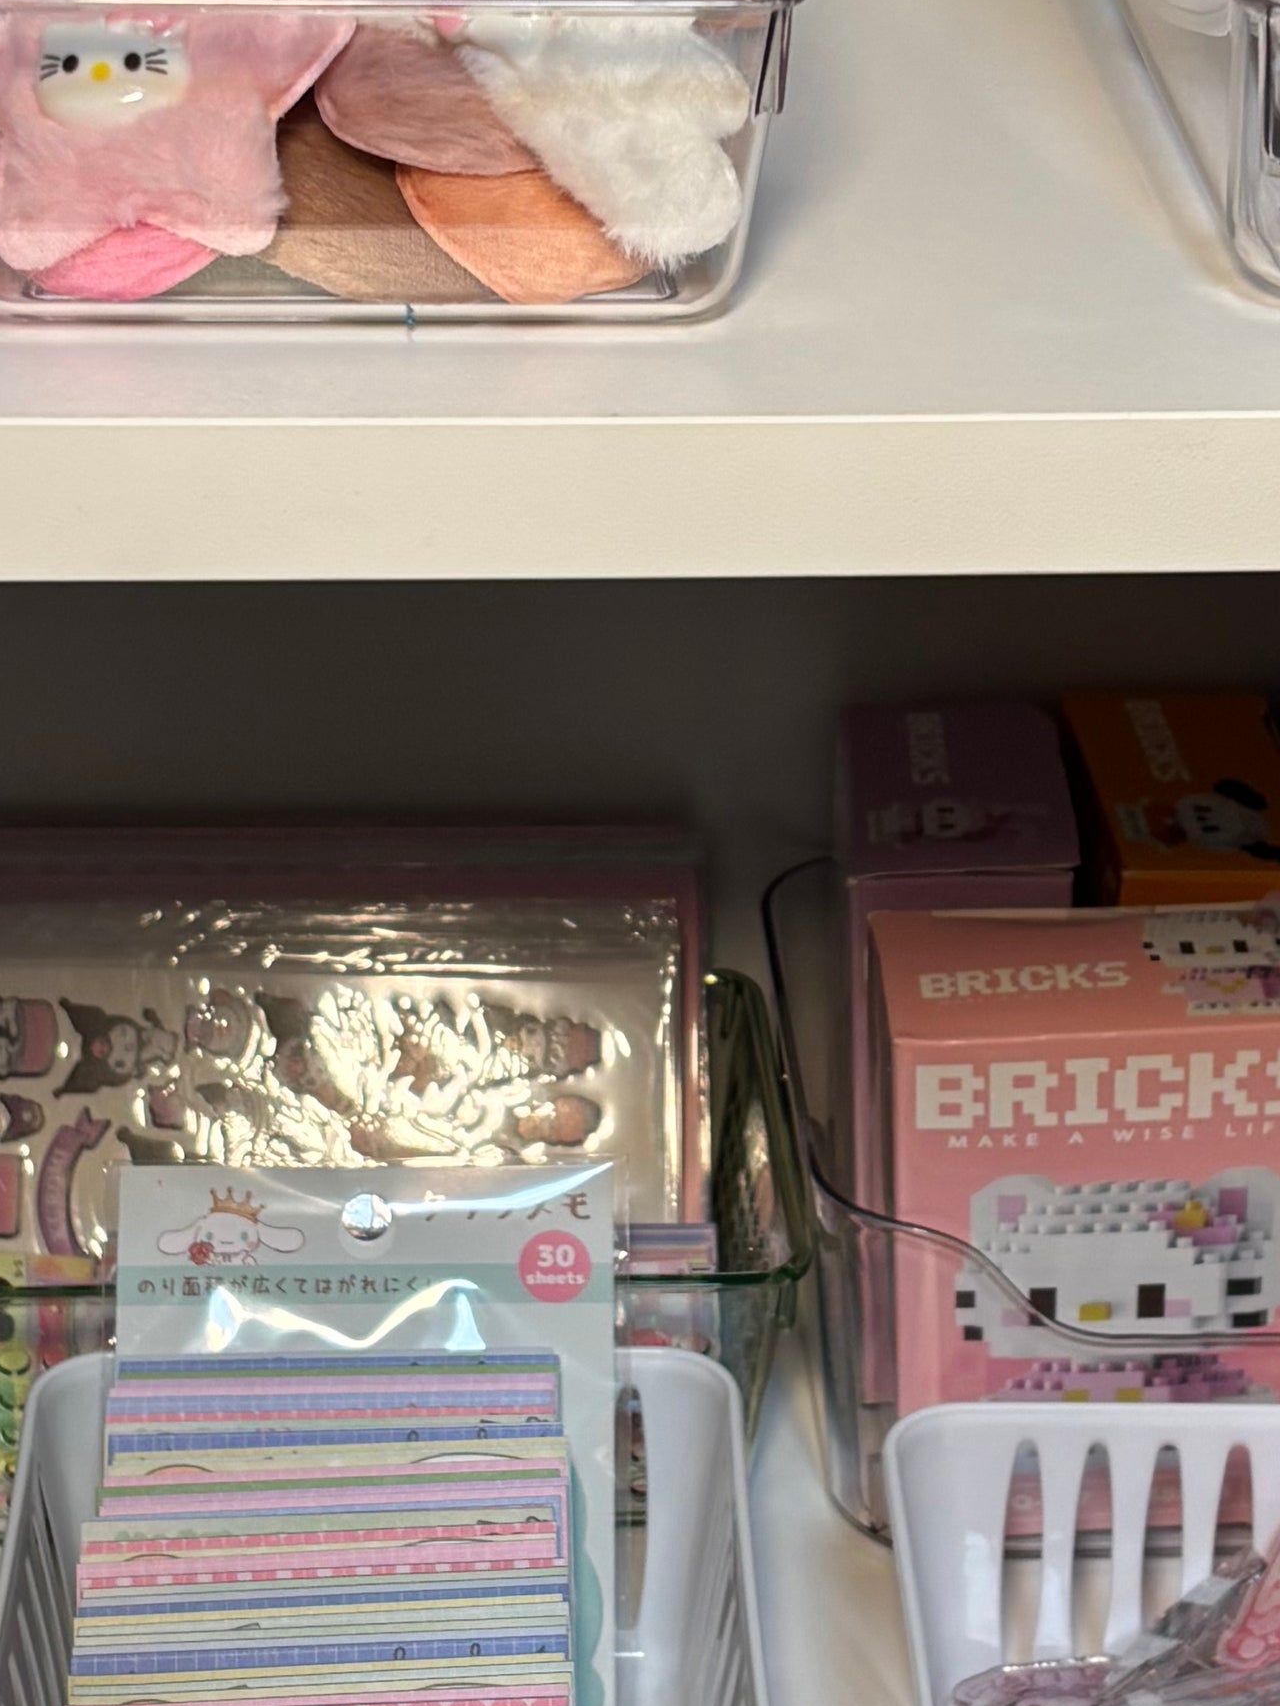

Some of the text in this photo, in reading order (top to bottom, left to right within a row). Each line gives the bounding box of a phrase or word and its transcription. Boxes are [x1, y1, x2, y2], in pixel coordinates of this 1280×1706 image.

[918, 961, 1131, 1000] BRICKS
[947, 1131, 1040, 1149] MAKE
[1068, 1130, 1085, 1145] A
[1113, 1124, 1196, 1143] WISE
[537, 1244, 576, 1267] 30
[525, 1271, 586, 1286] sheets
